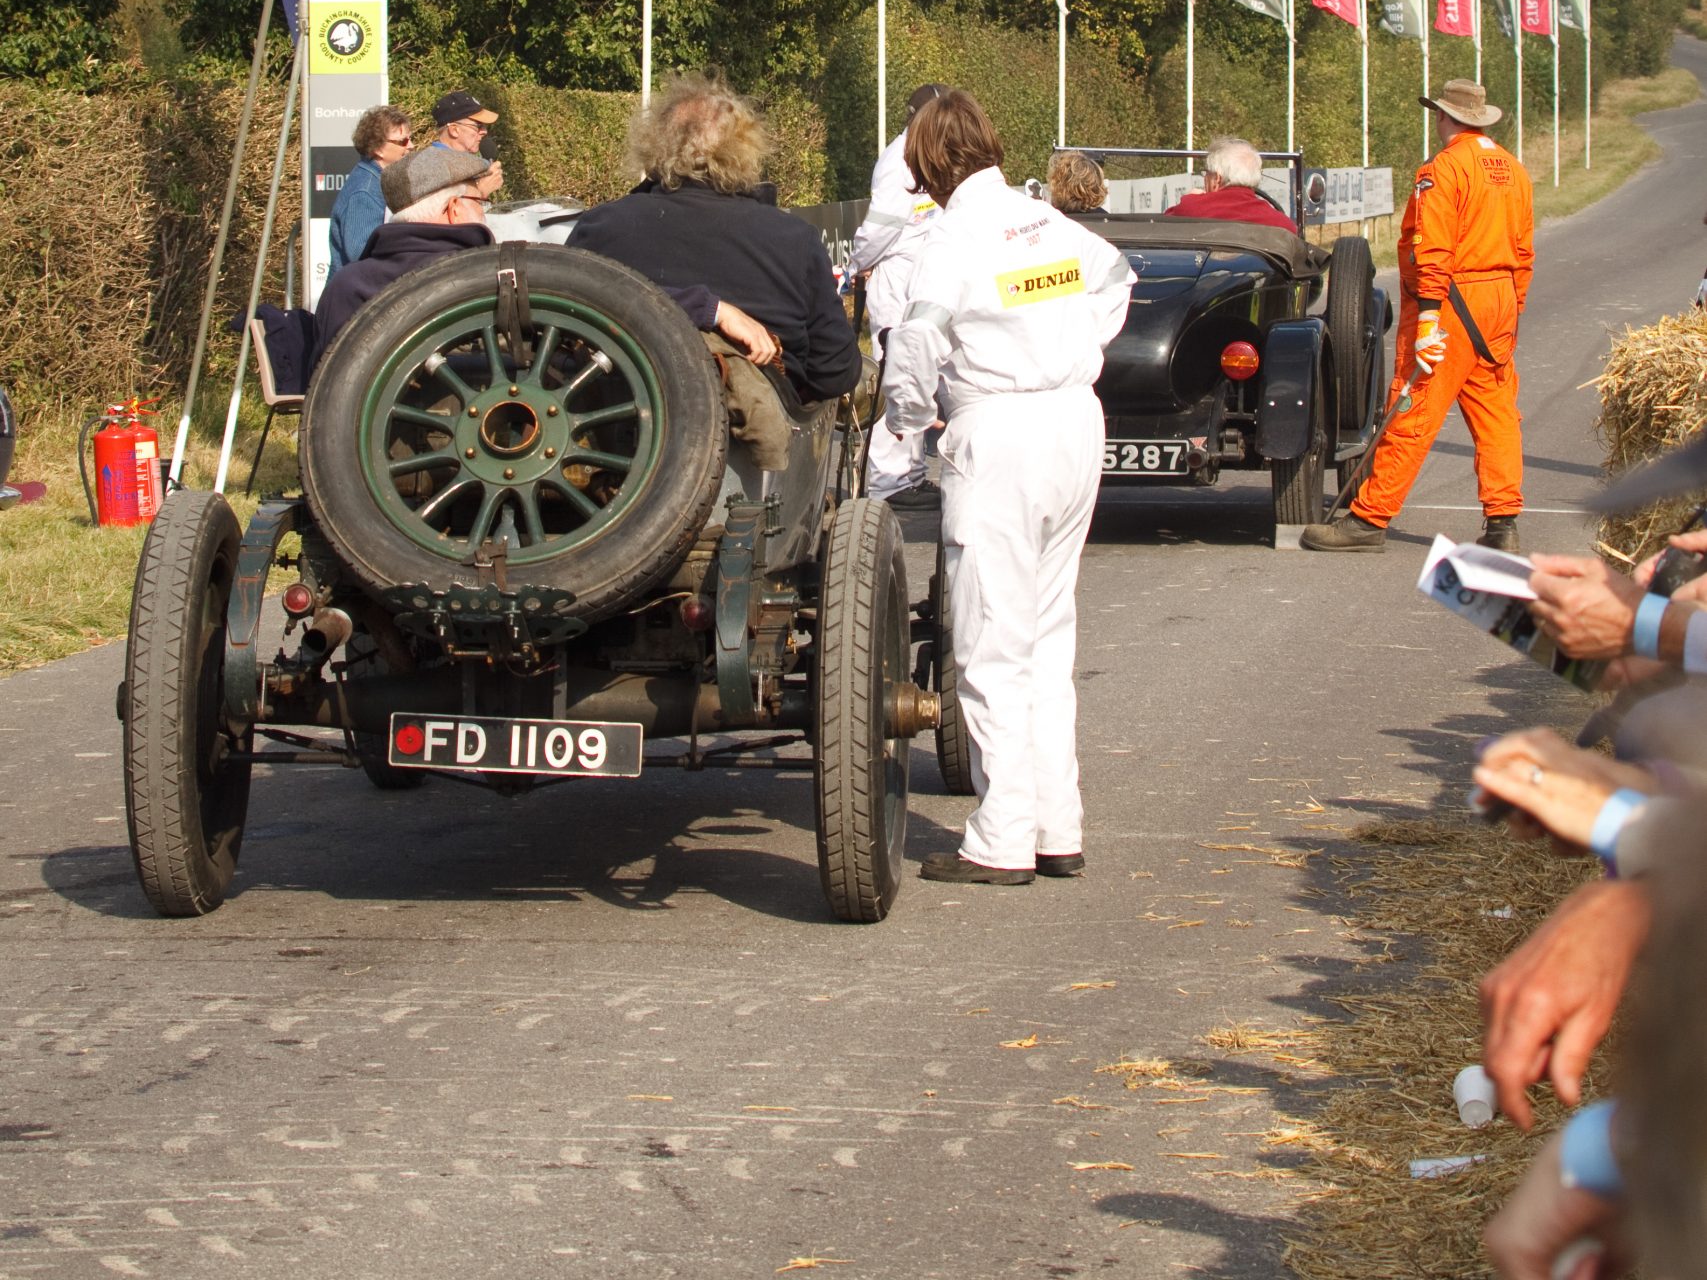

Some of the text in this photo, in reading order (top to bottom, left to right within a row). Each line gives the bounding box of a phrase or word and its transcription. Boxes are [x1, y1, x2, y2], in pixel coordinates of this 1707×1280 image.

[319, 10, 372, 38] BUCKINGHAMSHIRE
[319, 41, 372, 65] COUNTY COUNCIL
[1004, 228, 1018, 241] 24
[424, 721, 608, 770] FD 1109
